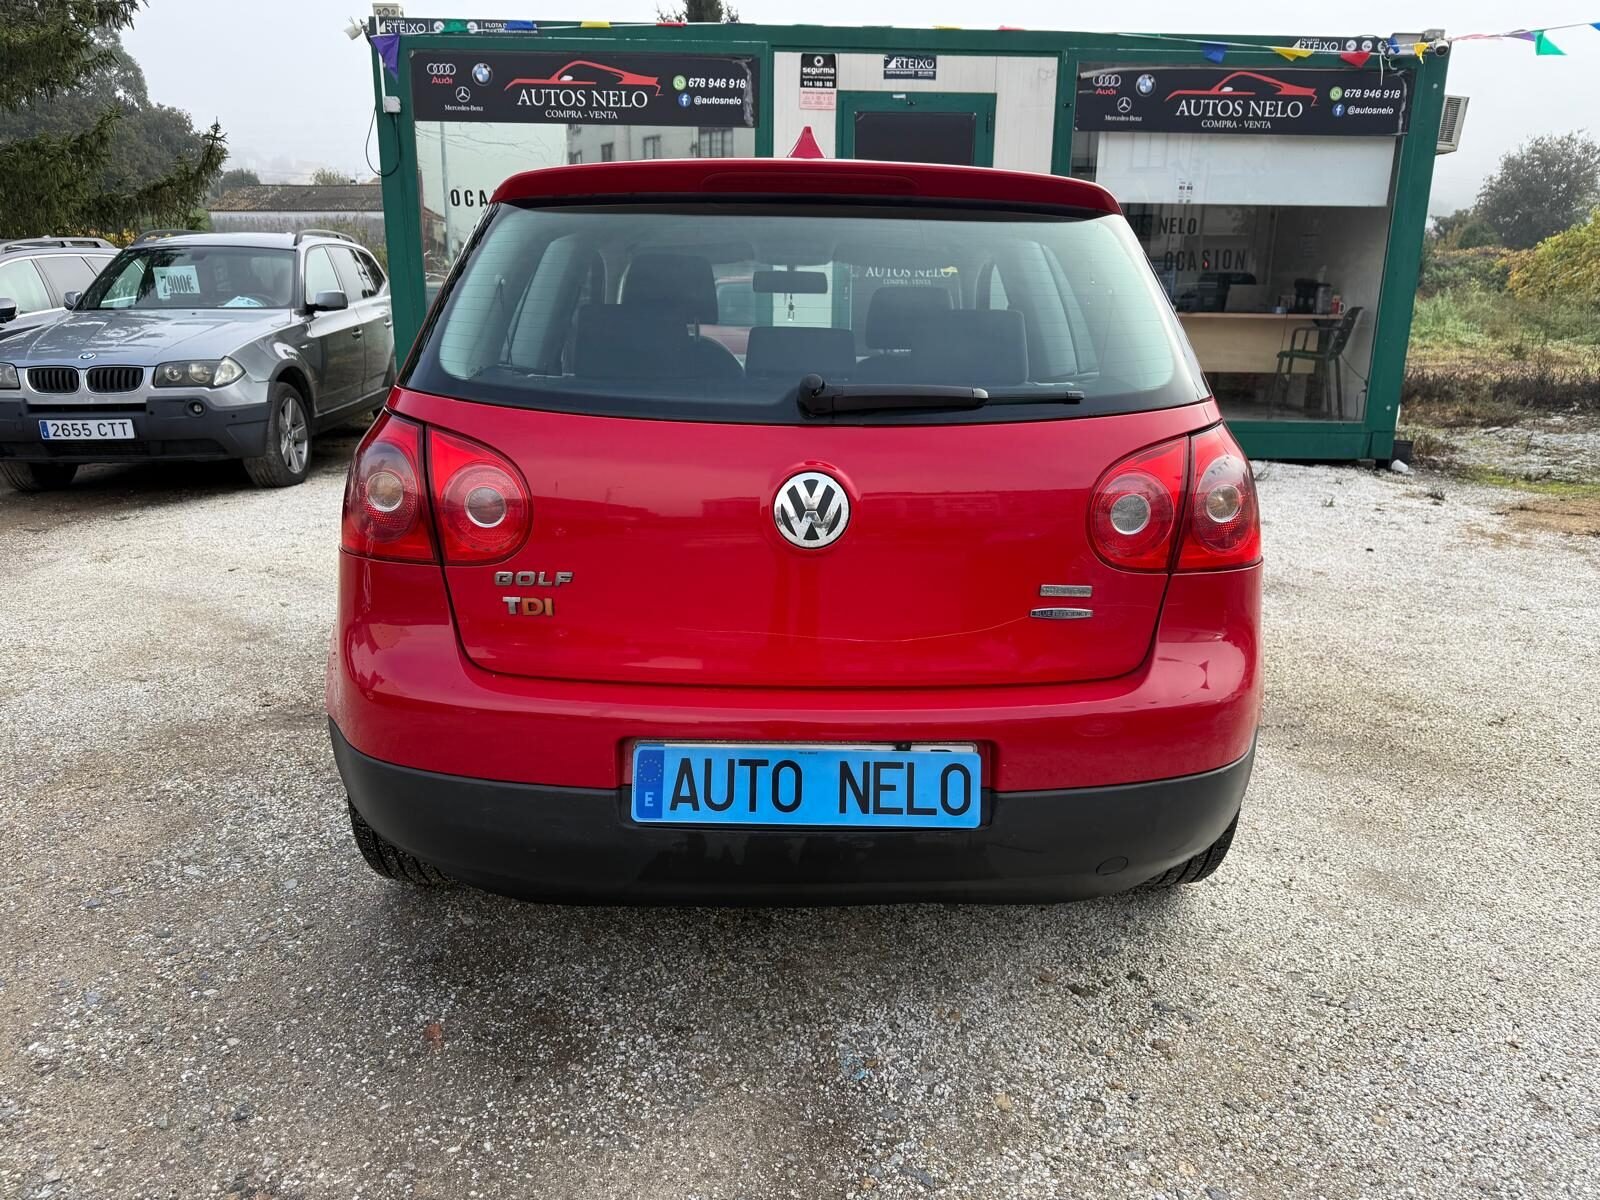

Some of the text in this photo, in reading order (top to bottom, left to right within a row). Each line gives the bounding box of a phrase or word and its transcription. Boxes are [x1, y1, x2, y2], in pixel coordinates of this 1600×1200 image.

[431, 76, 453, 85] Audi
[688, 78, 746, 89] 678 946 918
[516, 88, 648, 109] AUTOS NELO
[1095, 87, 1117, 95] Audi
[1344, 88, 1401, 98] 678 946 918
[694, 96, 742, 105] @autosnelo
[545, 110, 583, 119] COMPRA
[589, 111, 618, 120] VENTA
[1176, 99, 1304, 119] AUTOS NELO
[1347, 106, 1394, 115] @autosnelo
[1201, 119, 1238, 129] COMPRA
[1243, 120, 1272, 129] VENTA
[450, 189, 489, 207] OCA
[1160, 217, 1197, 234] NELO
[1164, 249, 1246, 271] OCASION
[159, 274, 195, 294] 7900€
[51, 422, 128, 437] 2655 CTT
[494, 571, 573, 587] GOLF
[502, 596, 554, 617] TDI
[668, 757, 973, 817] AUTO NELO
[644, 791, 655, 807] E
